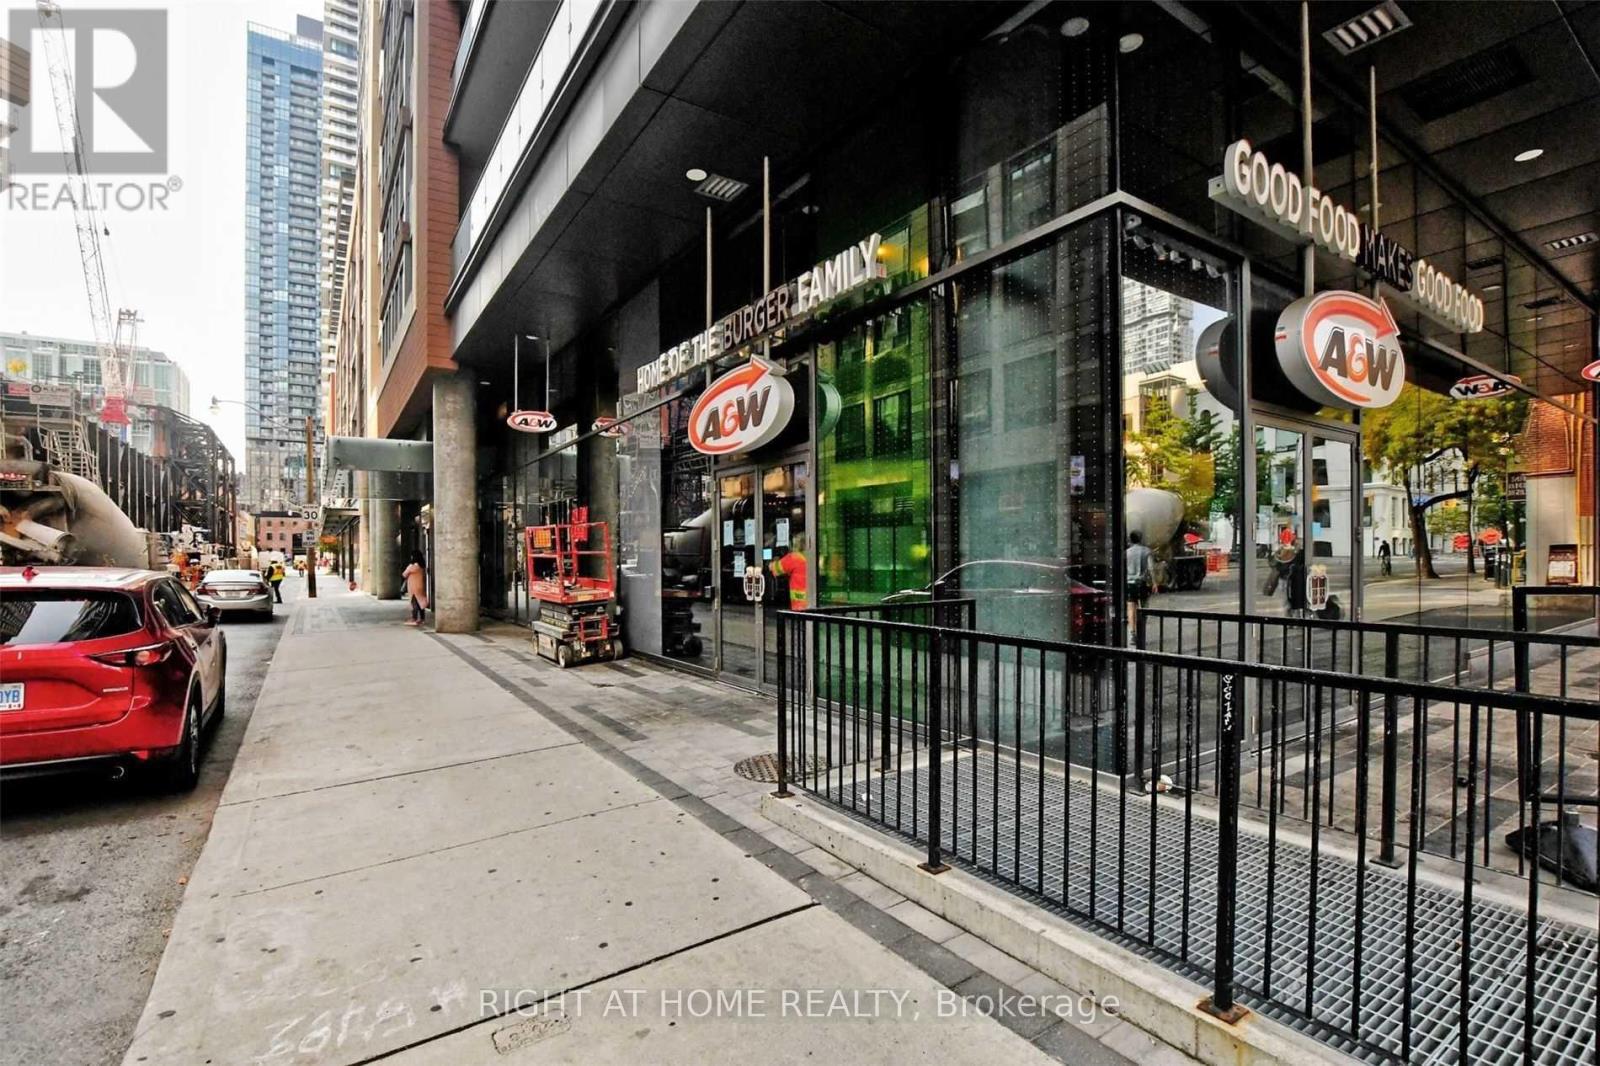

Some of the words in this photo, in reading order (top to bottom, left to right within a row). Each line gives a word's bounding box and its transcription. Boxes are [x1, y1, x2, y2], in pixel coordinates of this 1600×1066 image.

[1225, 139, 1302, 224] GOOD
[1304, 186, 1361, 262] FOOD
[1363, 224, 1413, 291] MAKES
[1416, 259, 1453, 313] GOOD
[1453, 283, 1484, 332] FOOD
[637, 352, 669, 394] HOME
[668, 341, 691, 377] OF
[691, 325, 723, 364] THE
[722, 287, 790, 350] BURGER
[793, 232, 882, 316] FAMILY
[1317, 327, 1398, 391] A&W
[518, 417, 553, 428] A&W
[701, 386, 773, 443] A&W
[304, 510, 318, 520] 30
